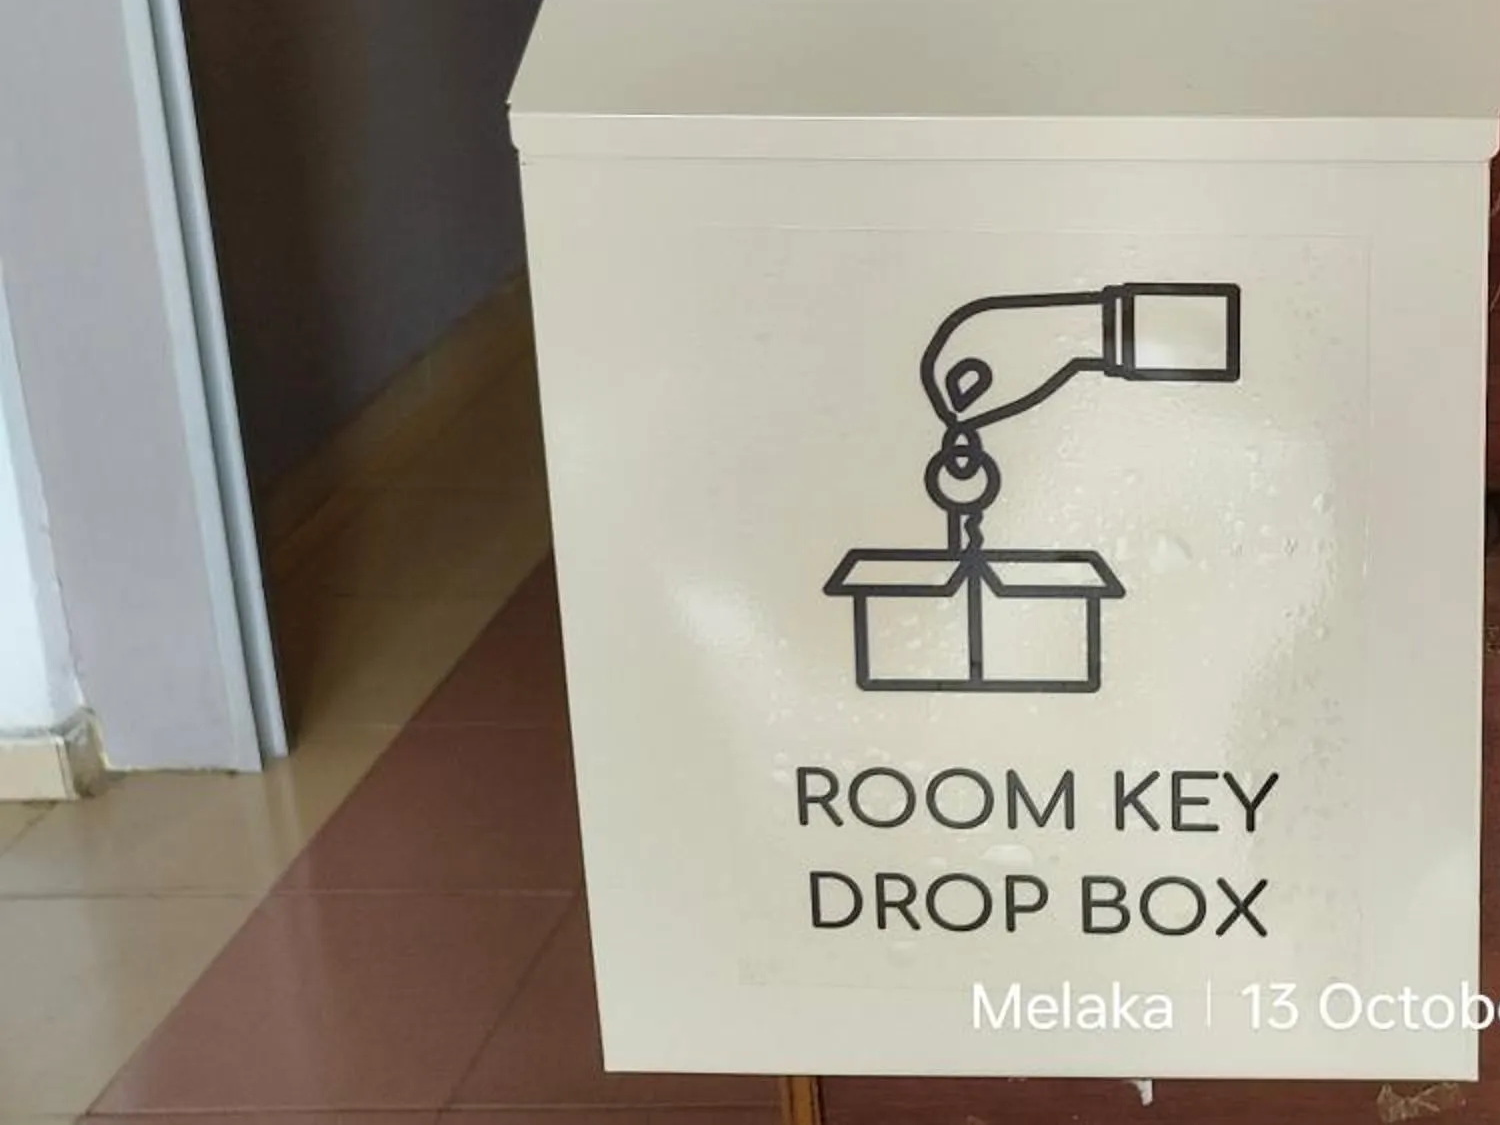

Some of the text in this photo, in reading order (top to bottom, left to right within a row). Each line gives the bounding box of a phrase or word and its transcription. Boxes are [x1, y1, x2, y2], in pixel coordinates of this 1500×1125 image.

[796, 766, 1280, 833] ROOM KEY
[809, 871, 1268, 938] DROP BOX
